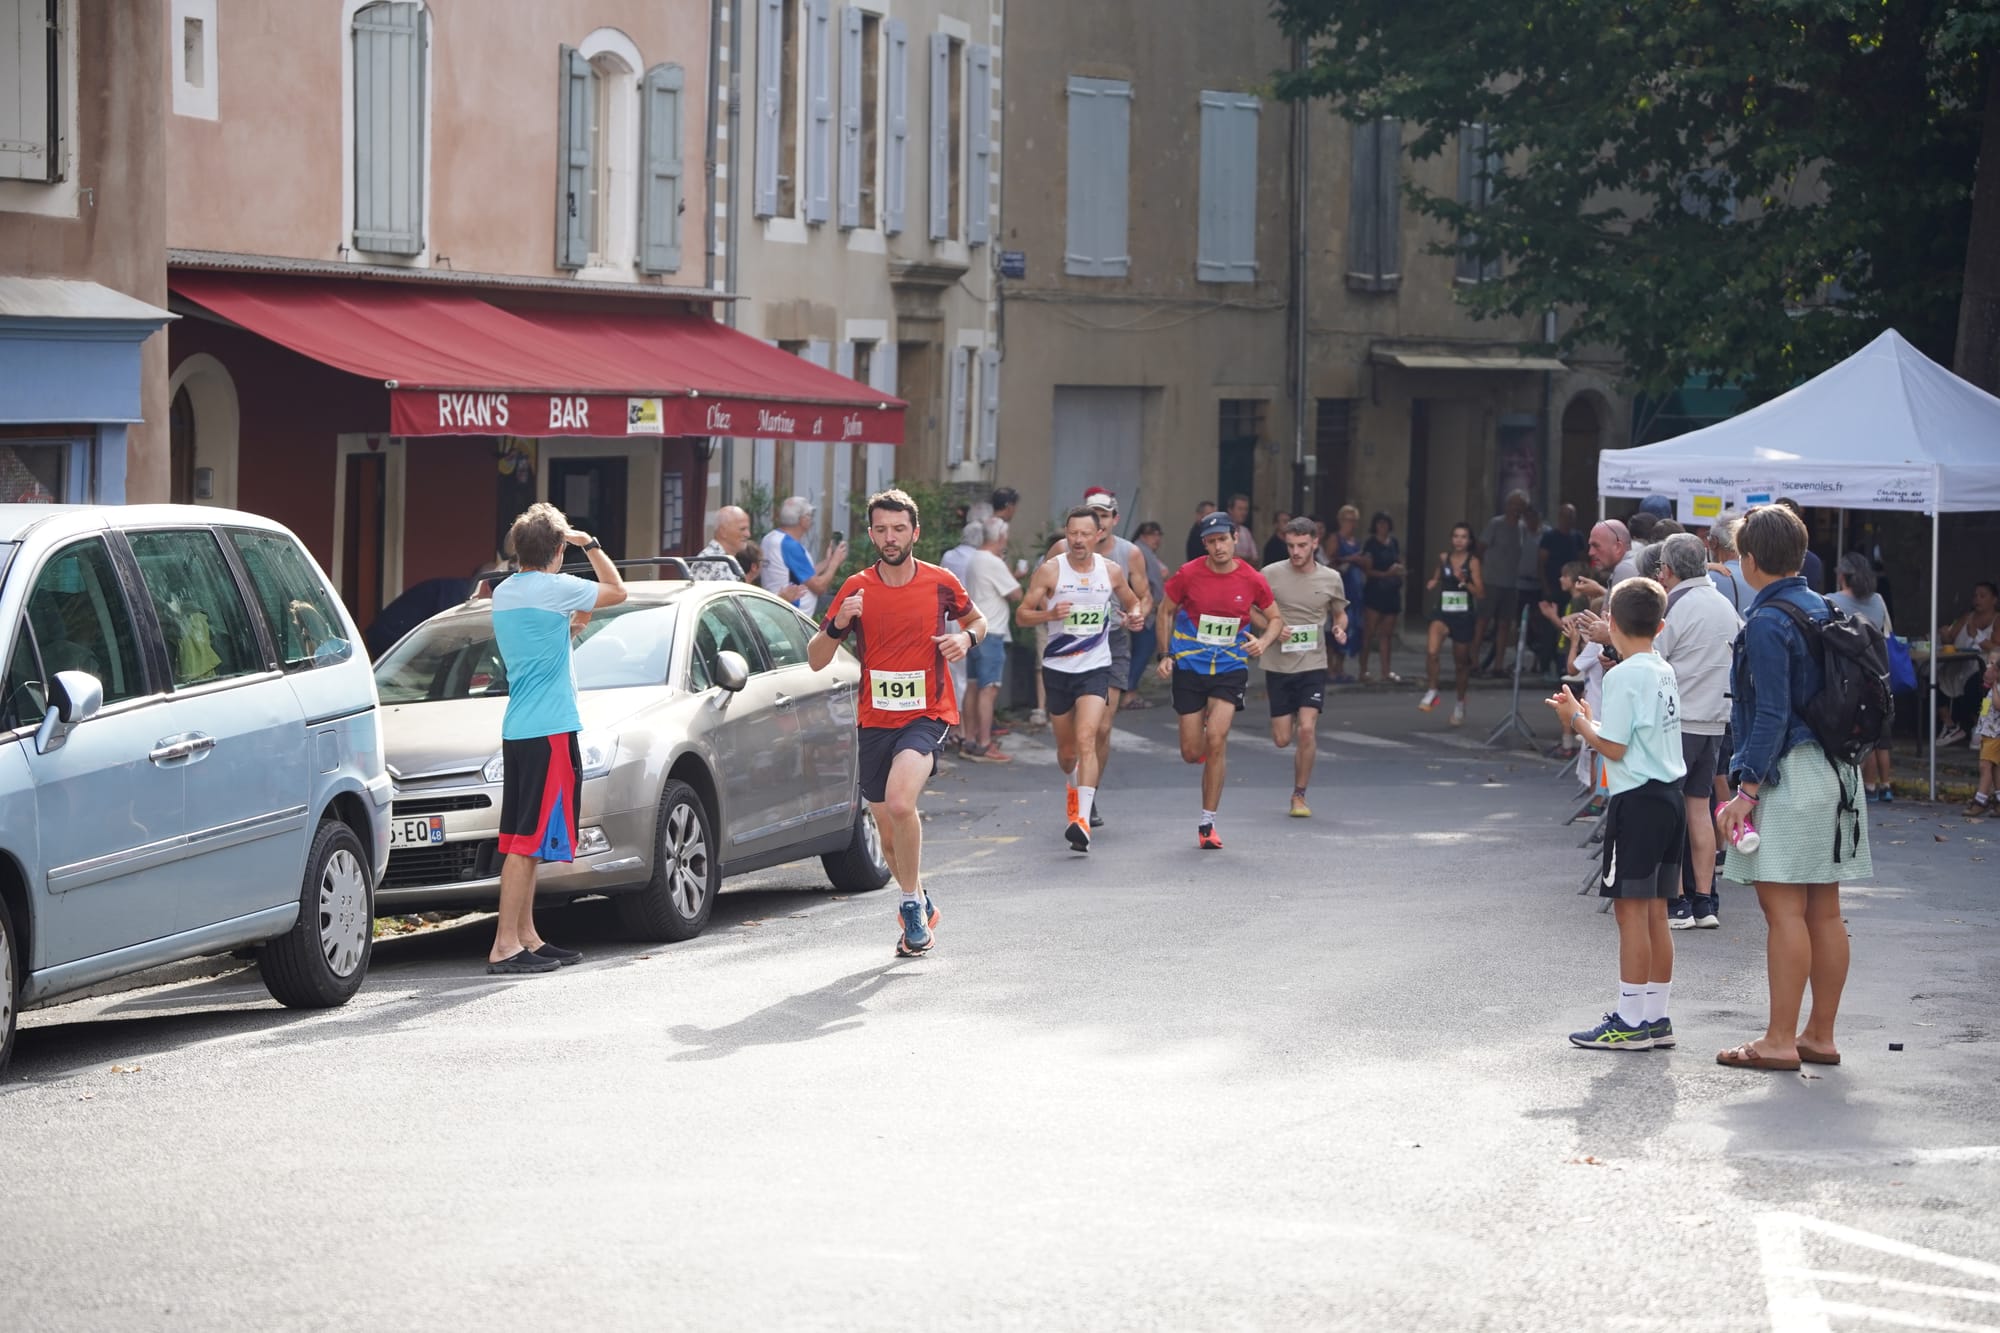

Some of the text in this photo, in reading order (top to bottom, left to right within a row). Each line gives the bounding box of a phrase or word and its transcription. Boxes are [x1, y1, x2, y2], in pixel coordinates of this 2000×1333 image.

[438, 393, 589, 428] RYAN'S BAR
[707, 403, 864, 440] Chez Martine et John
[1447, 596, 1460, 605] 21
[1071, 612, 1099, 625] 122
[1205, 622, 1233, 636] 111
[1291, 631, 1308, 643] 33
[879, 681, 915, 698] 191
[431, 829, 442, 841] 48
